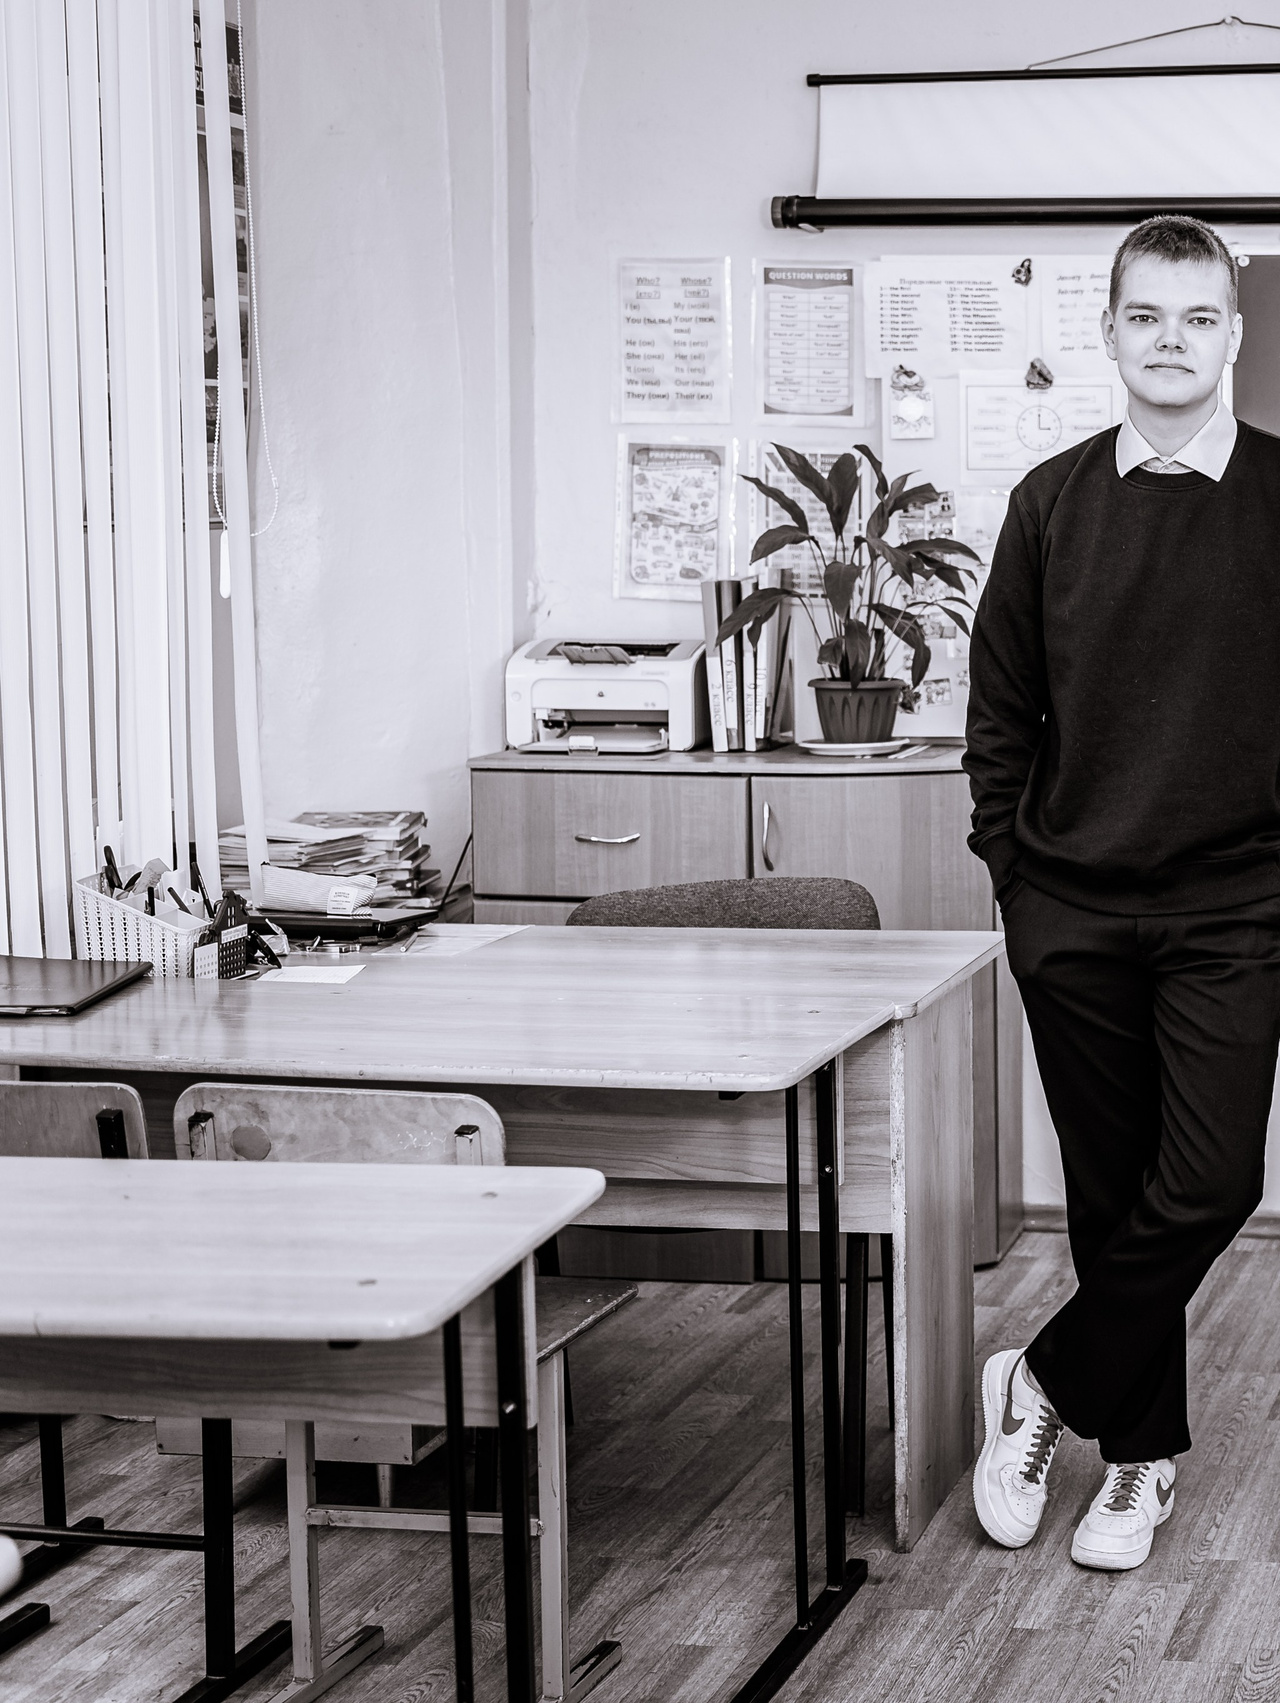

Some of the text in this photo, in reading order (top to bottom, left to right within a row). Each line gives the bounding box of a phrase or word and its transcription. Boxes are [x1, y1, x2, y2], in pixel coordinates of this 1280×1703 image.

[769, 272, 847, 281] QUESTION WORDS
[635, 277, 661, 287] Who?
[680, 277, 712, 287] Whose?
[635, 290, 661, 299] (кто?)
[673, 302, 685, 311] My
[625, 316, 642, 324] You
[673, 315, 693, 323] Your
[625, 338, 655, 348] He (он)
[673, 339, 687, 347] His
[625, 352, 664, 361] She (она)
[674, 352, 688, 360] Her
[625, 378, 639, 386] We
[674, 378, 690, 387] Our
[624, 391, 646, 401] They
[675, 391, 695, 400] Their
[756, 668, 767, 680] 10
[726, 659, 737, 703] 6 класс
[747, 682, 756, 690] 9
[713, 694, 722, 726] класс
